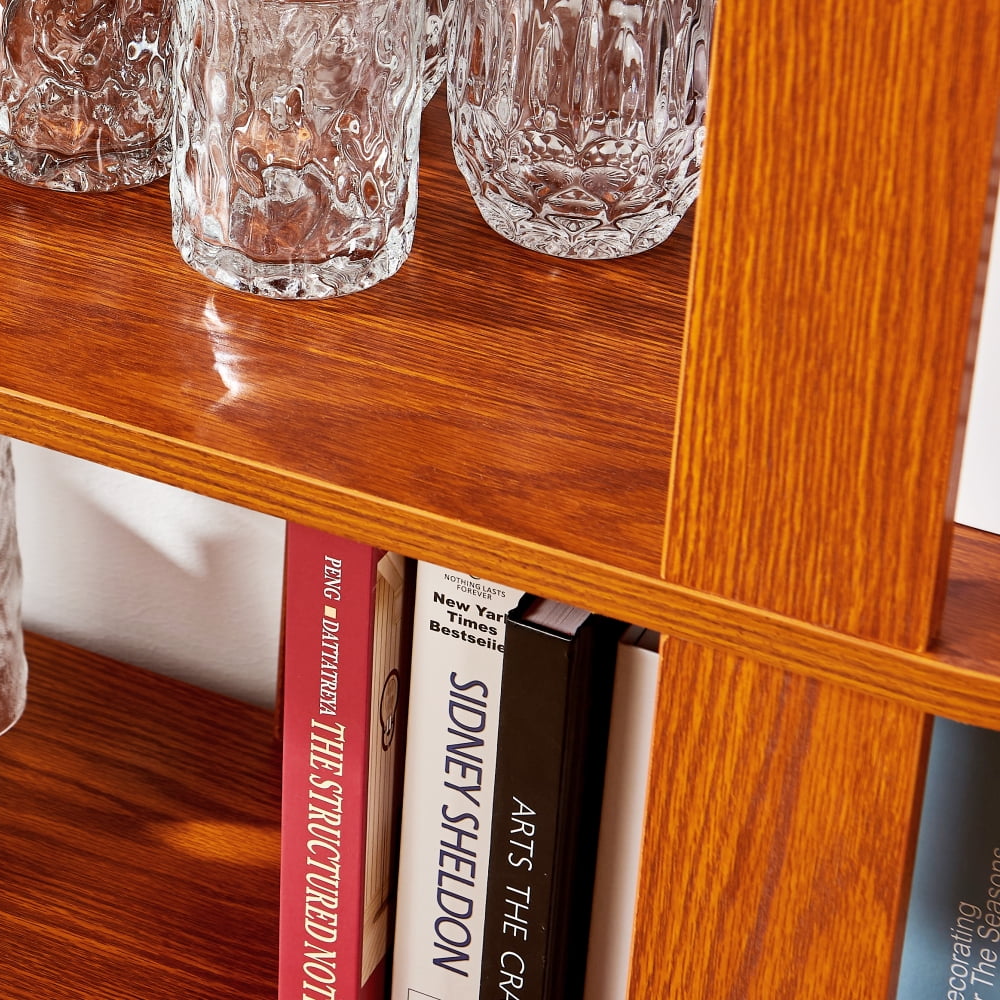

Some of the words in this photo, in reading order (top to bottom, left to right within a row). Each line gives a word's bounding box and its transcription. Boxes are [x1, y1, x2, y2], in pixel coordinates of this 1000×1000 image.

[324, 554, 342, 601] PENG
[433, 591, 470, 612] New
[444, 573, 481, 590] NOTHING
[483, 586, 506, 598] LASTS
[456, 584, 492, 601] FOREVER
[447, 610, 498, 636] Times
[319, 617, 340, 716] DATTATREYA
[309, 718, 346, 777] THE
[443, 671, 489, 807] SIDNEY
[303, 773, 344, 943] STRUCTURED
[508, 796, 536, 872] ARTS
[432, 804, 480, 978] SHELDON
[503, 886, 531, 941] THE
[303, 940, 337, 1000] NOT
[947, 901, 982, 1000] ecorating
[970, 948, 997, 987] The
